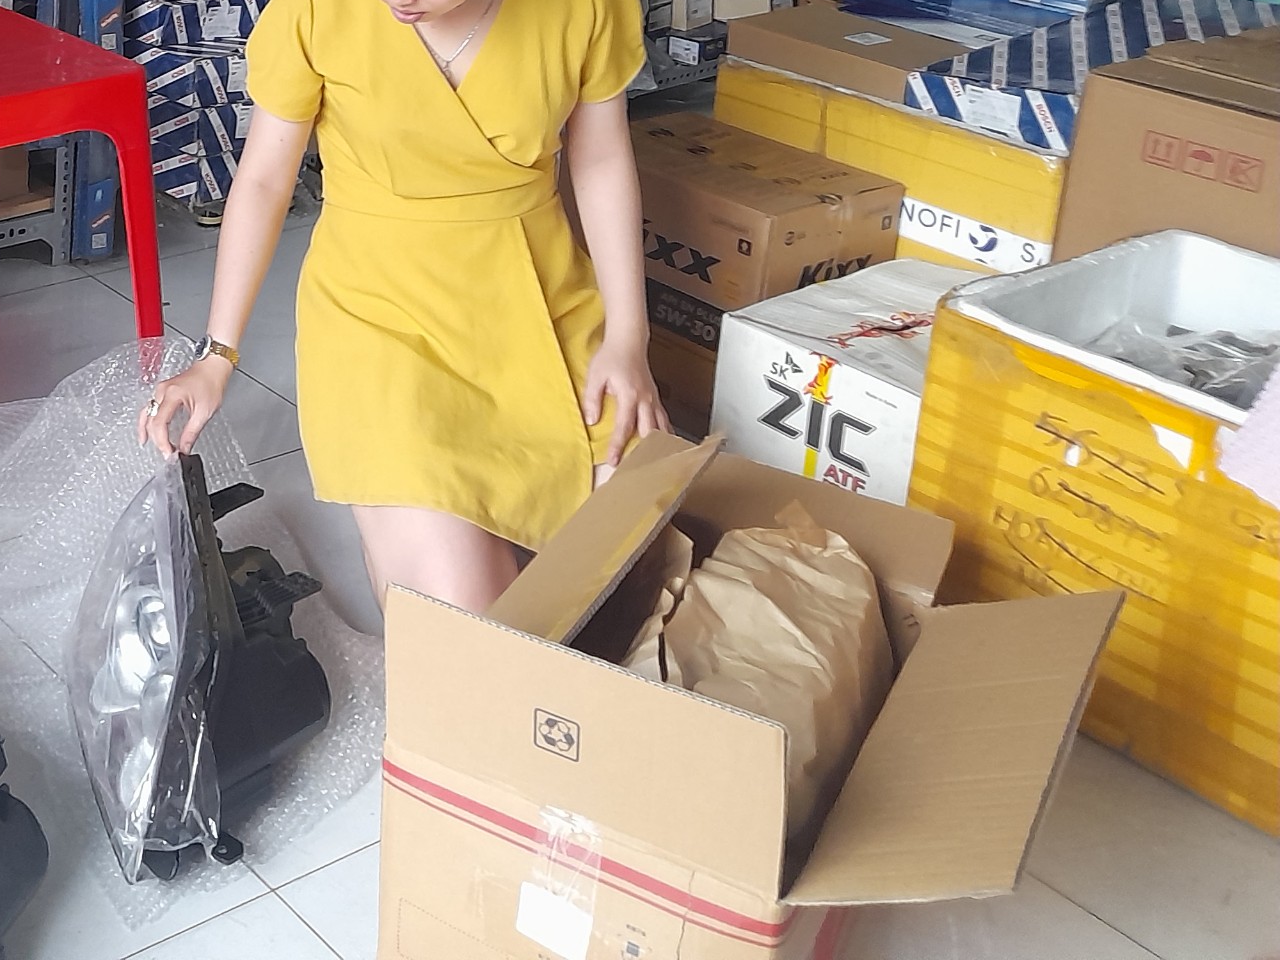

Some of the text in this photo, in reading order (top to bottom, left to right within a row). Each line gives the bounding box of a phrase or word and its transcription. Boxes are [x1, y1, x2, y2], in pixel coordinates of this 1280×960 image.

[1035, 103, 1055, 134] BOSCH
[899, 199, 961, 238] NOFI
[654, 303, 717, 342] 5W-30
[770, 361, 790, 381] SK
[757, 374, 878, 478] ZIC
[823, 463, 867, 492] ATF
